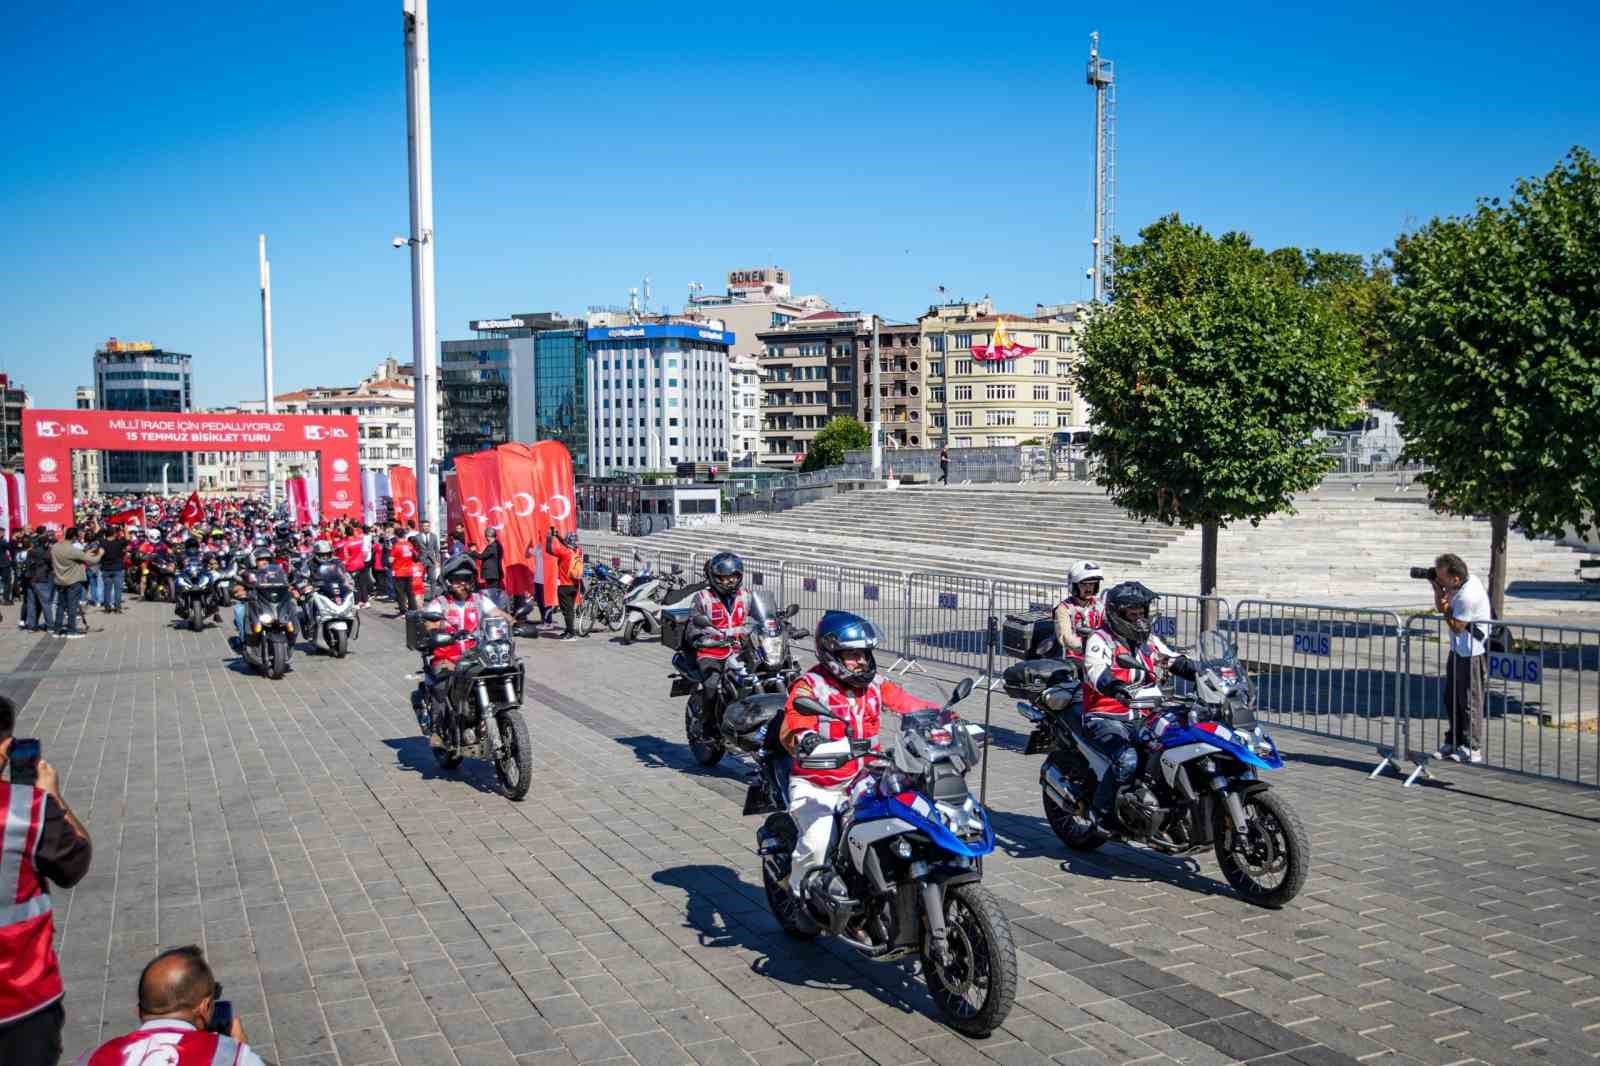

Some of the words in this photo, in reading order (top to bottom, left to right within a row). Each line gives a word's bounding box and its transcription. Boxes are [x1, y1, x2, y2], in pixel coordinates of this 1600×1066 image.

[126, 431, 138, 441] 15
[140, 431, 189, 442] TEMMUZ
[191, 431, 239, 443] BİSİKLET
[242, 432, 272, 443] TURU
